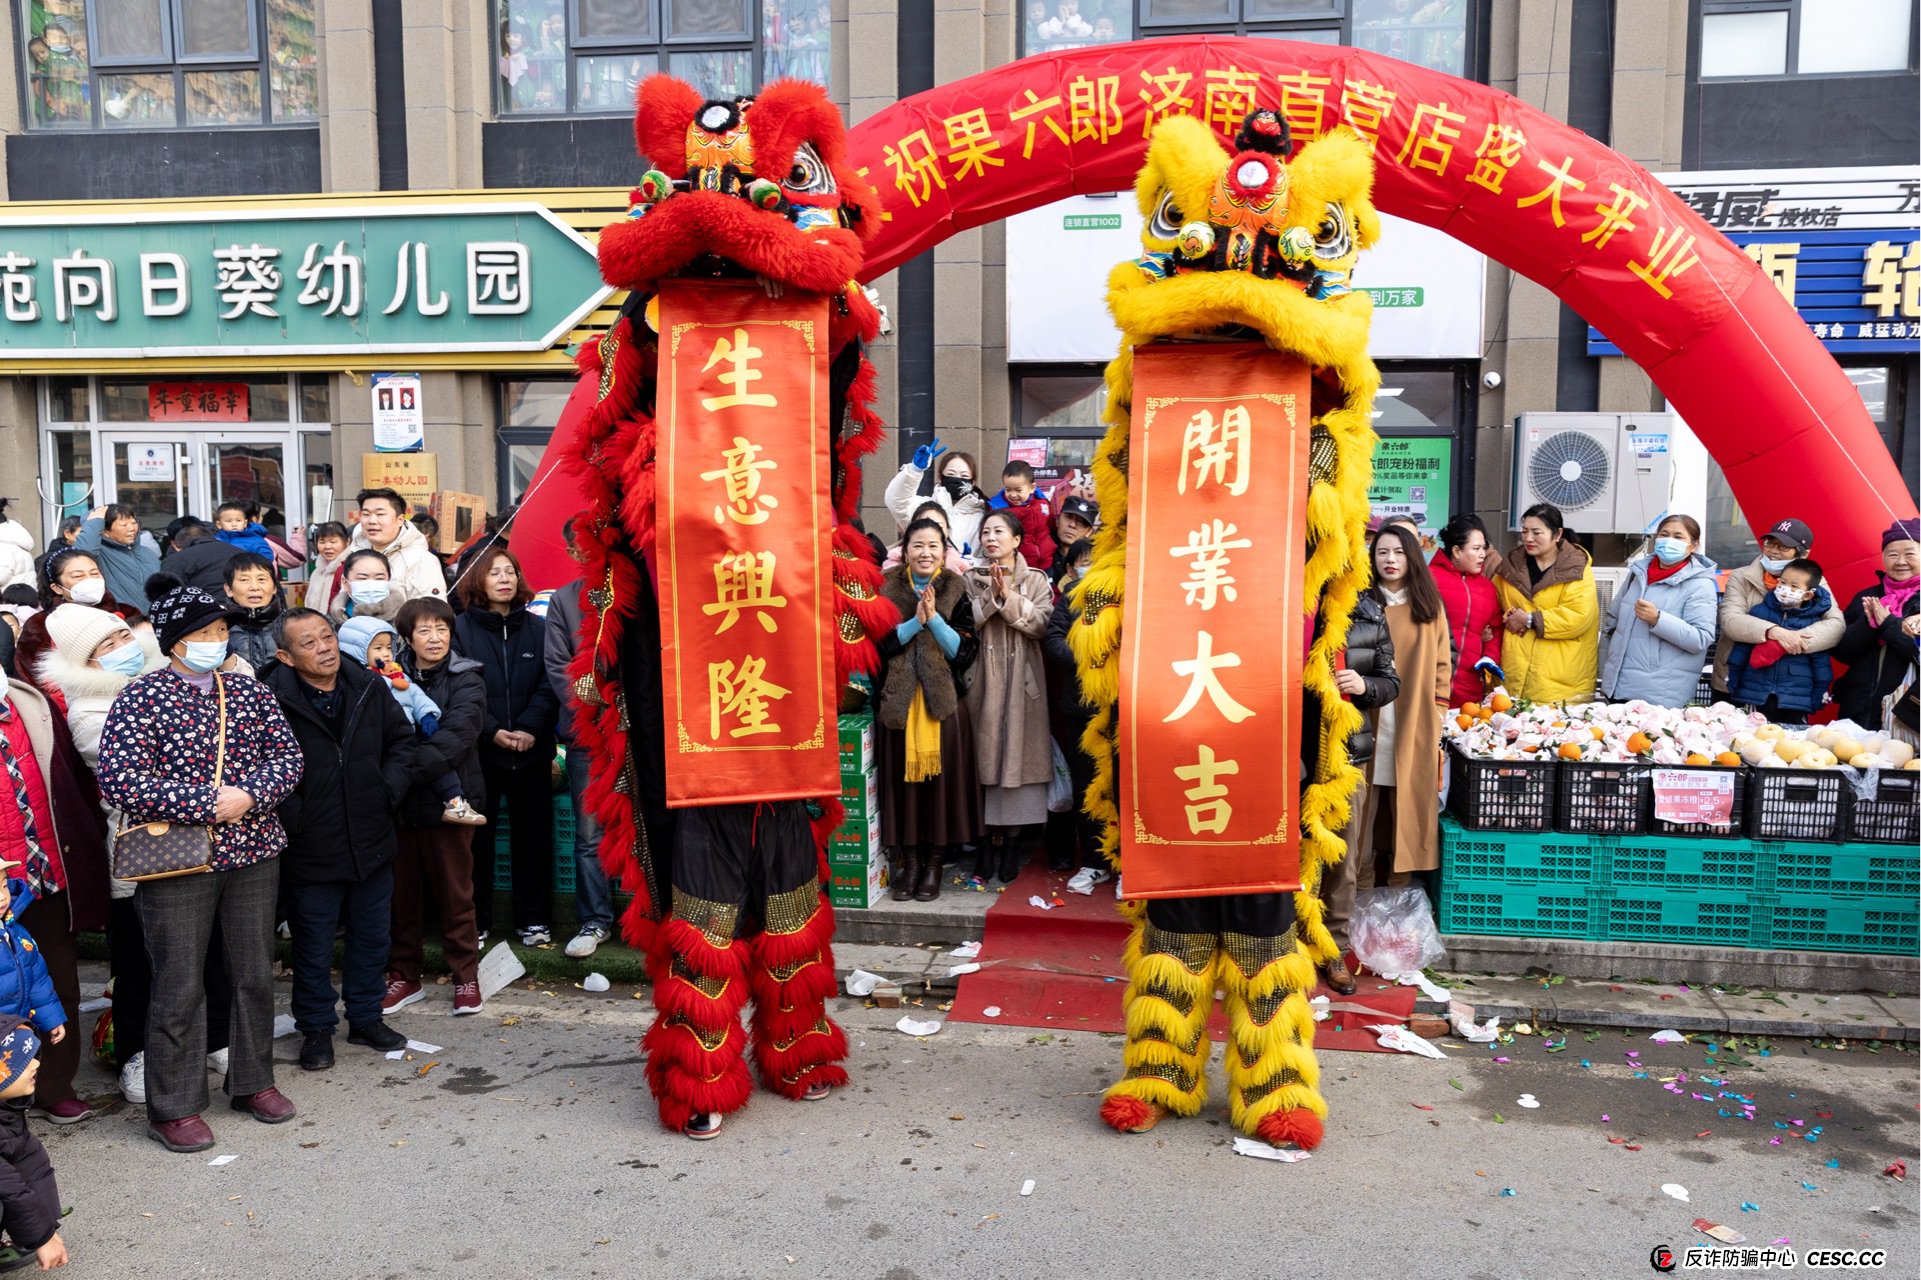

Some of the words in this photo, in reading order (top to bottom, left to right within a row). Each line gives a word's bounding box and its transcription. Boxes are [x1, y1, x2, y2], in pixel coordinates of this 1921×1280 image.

[857, 65, 1700, 300] 祝果六郎济南直营店盛大开业
[1064, 217, 1120, 227] 连锁直营1002
[1778, 205, 1842, 228] 授权店
[1369, 289, 1417, 306] 到万家
[1808, 323, 1845, 338] 寿命
[1858, 322, 1920, 338] 威猛动力
[699, 327, 793, 741] 生意興隆
[1161, 404, 1257, 836] 開業大吉
